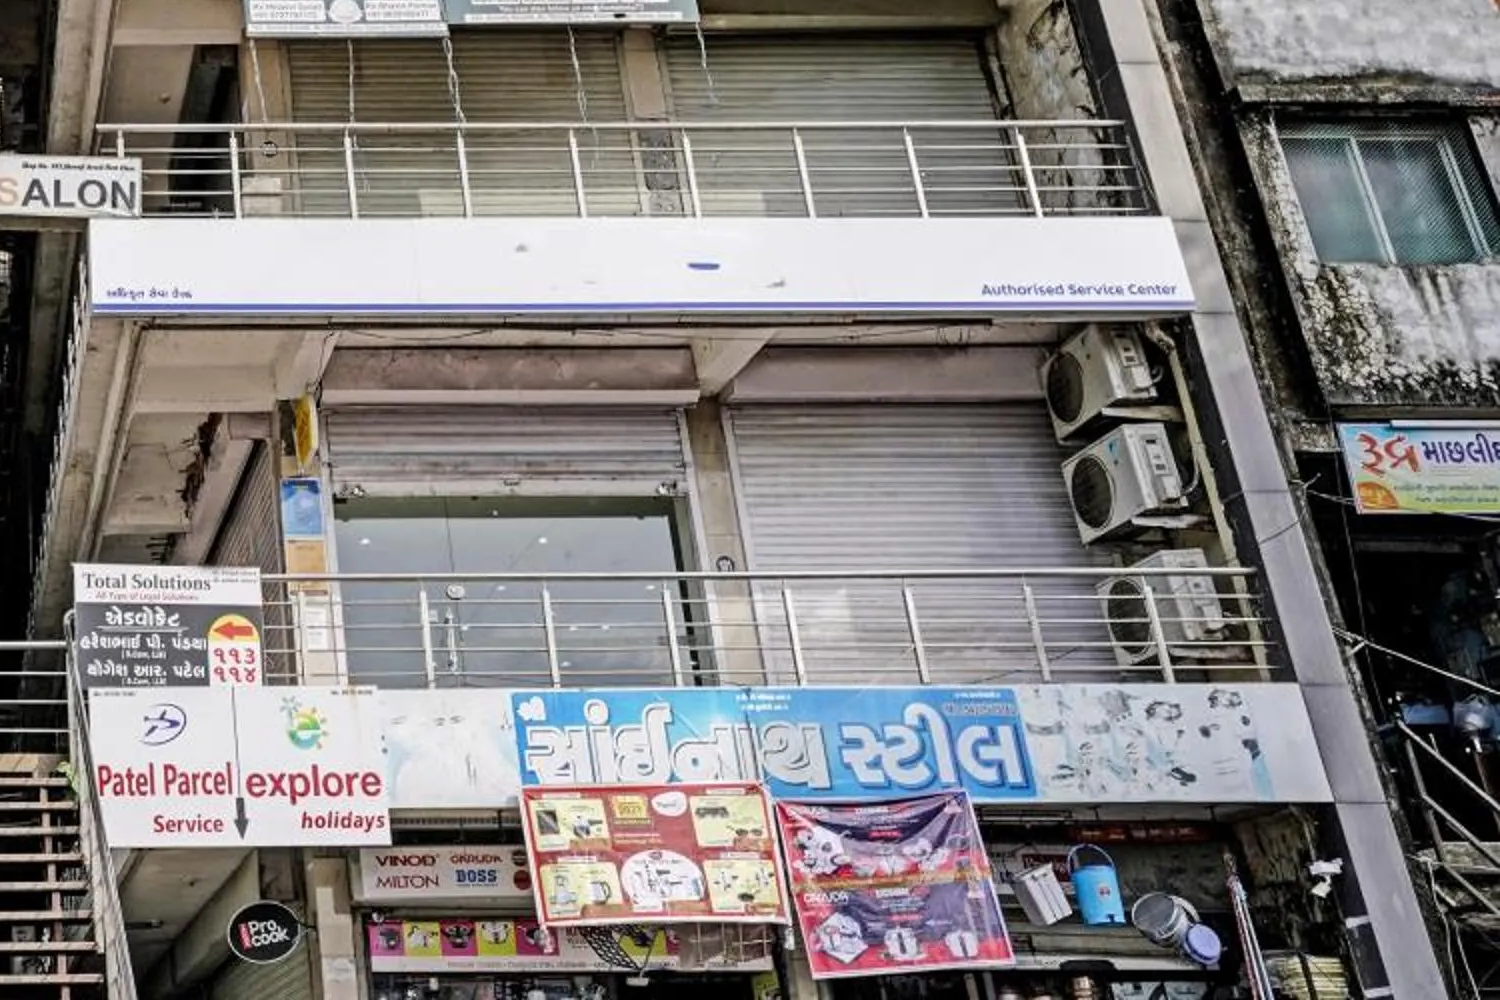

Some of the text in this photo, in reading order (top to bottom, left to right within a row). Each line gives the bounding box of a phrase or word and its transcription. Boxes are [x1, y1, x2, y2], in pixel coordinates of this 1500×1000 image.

[981, 282, 1178, 297] Authorised Service Center
[82, 572, 127, 590] Total
[131, 573, 211, 591] Solutions
[839, 702, 1029, 790] સ્ટીલ
[97, 761, 233, 797] Patel Parcel
[245, 763, 382, 805] explore
[153, 813, 225, 833] Service
[301, 810, 386, 833] holidays
[375, 854, 437, 867] VINOD
[375, 869, 498, 889] MILTON BOSS
[248, 920, 277, 938] Pro
[251, 925, 291, 948] cook
